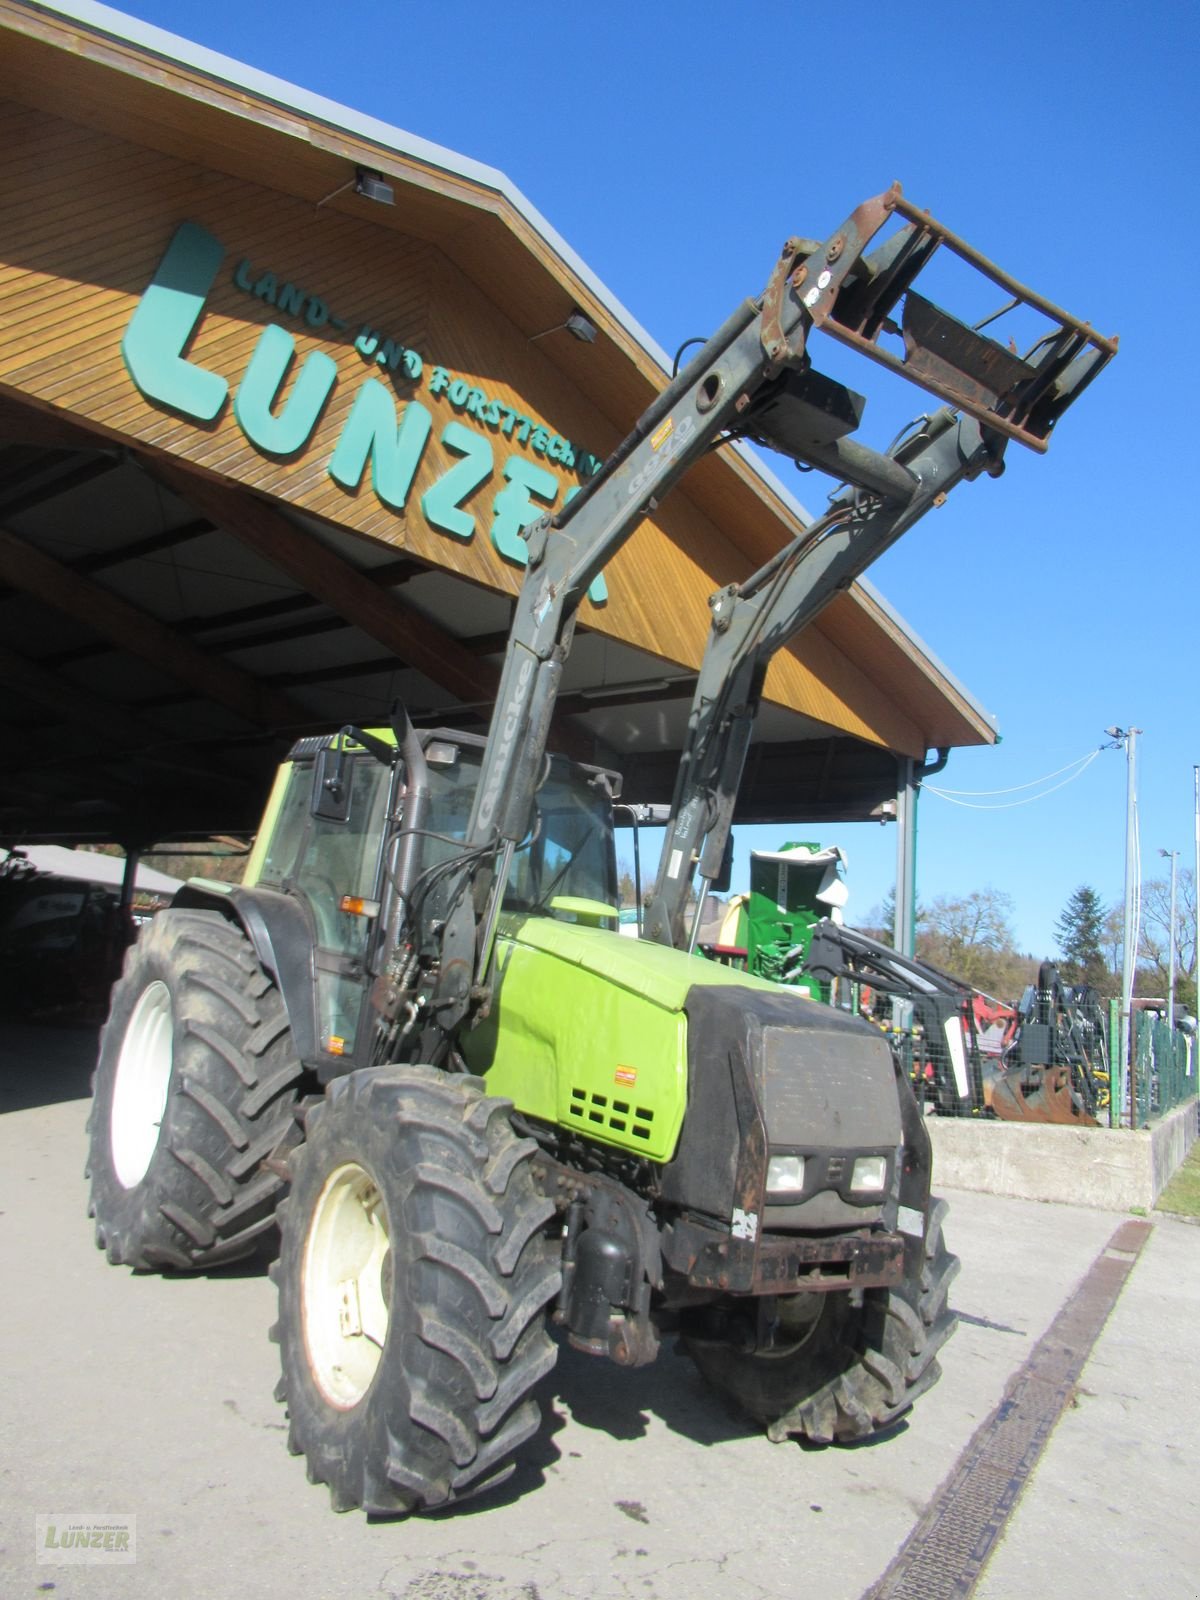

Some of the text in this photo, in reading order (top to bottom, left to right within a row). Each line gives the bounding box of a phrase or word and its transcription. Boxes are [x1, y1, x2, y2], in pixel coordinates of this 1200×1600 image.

[234, 257, 348, 327] LAND-
[355, 325, 423, 378] UND
[429, 365, 603, 477] FORSTTECHN
[478, 659, 533, 830] Quicke
